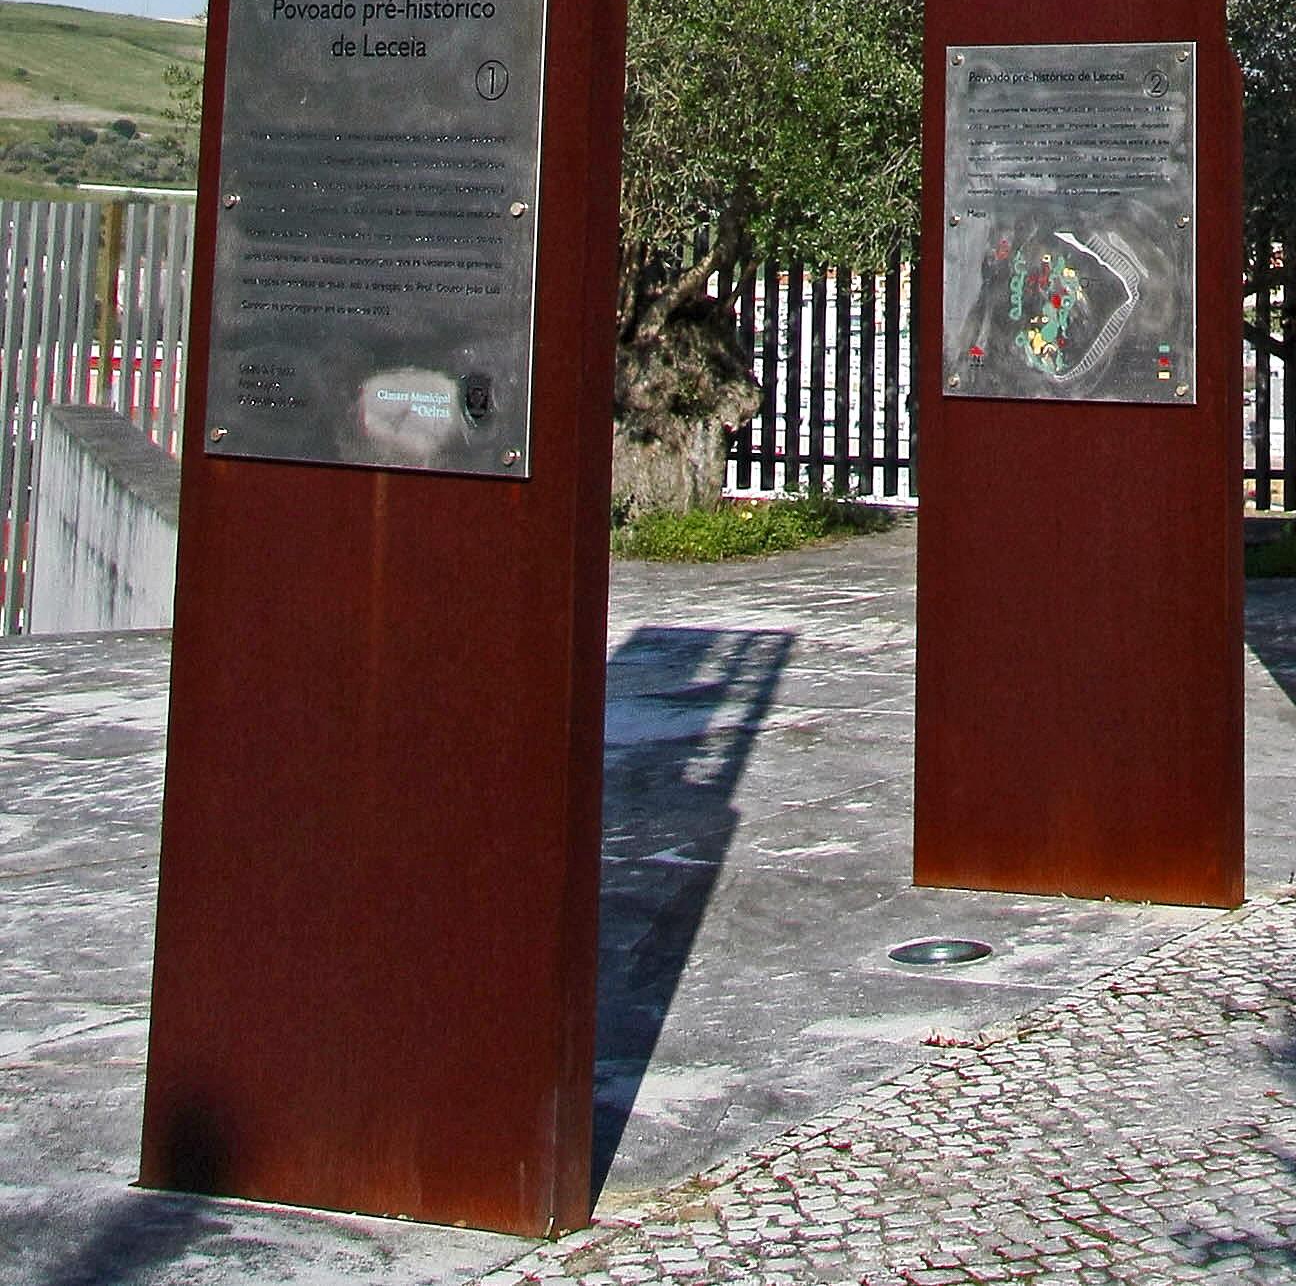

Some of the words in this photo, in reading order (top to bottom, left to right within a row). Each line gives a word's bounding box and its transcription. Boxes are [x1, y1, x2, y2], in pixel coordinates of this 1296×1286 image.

[331, 35, 357, 58] de
[363, 35, 427, 58] Leceia
[1078, 71, 1090, 83] de
